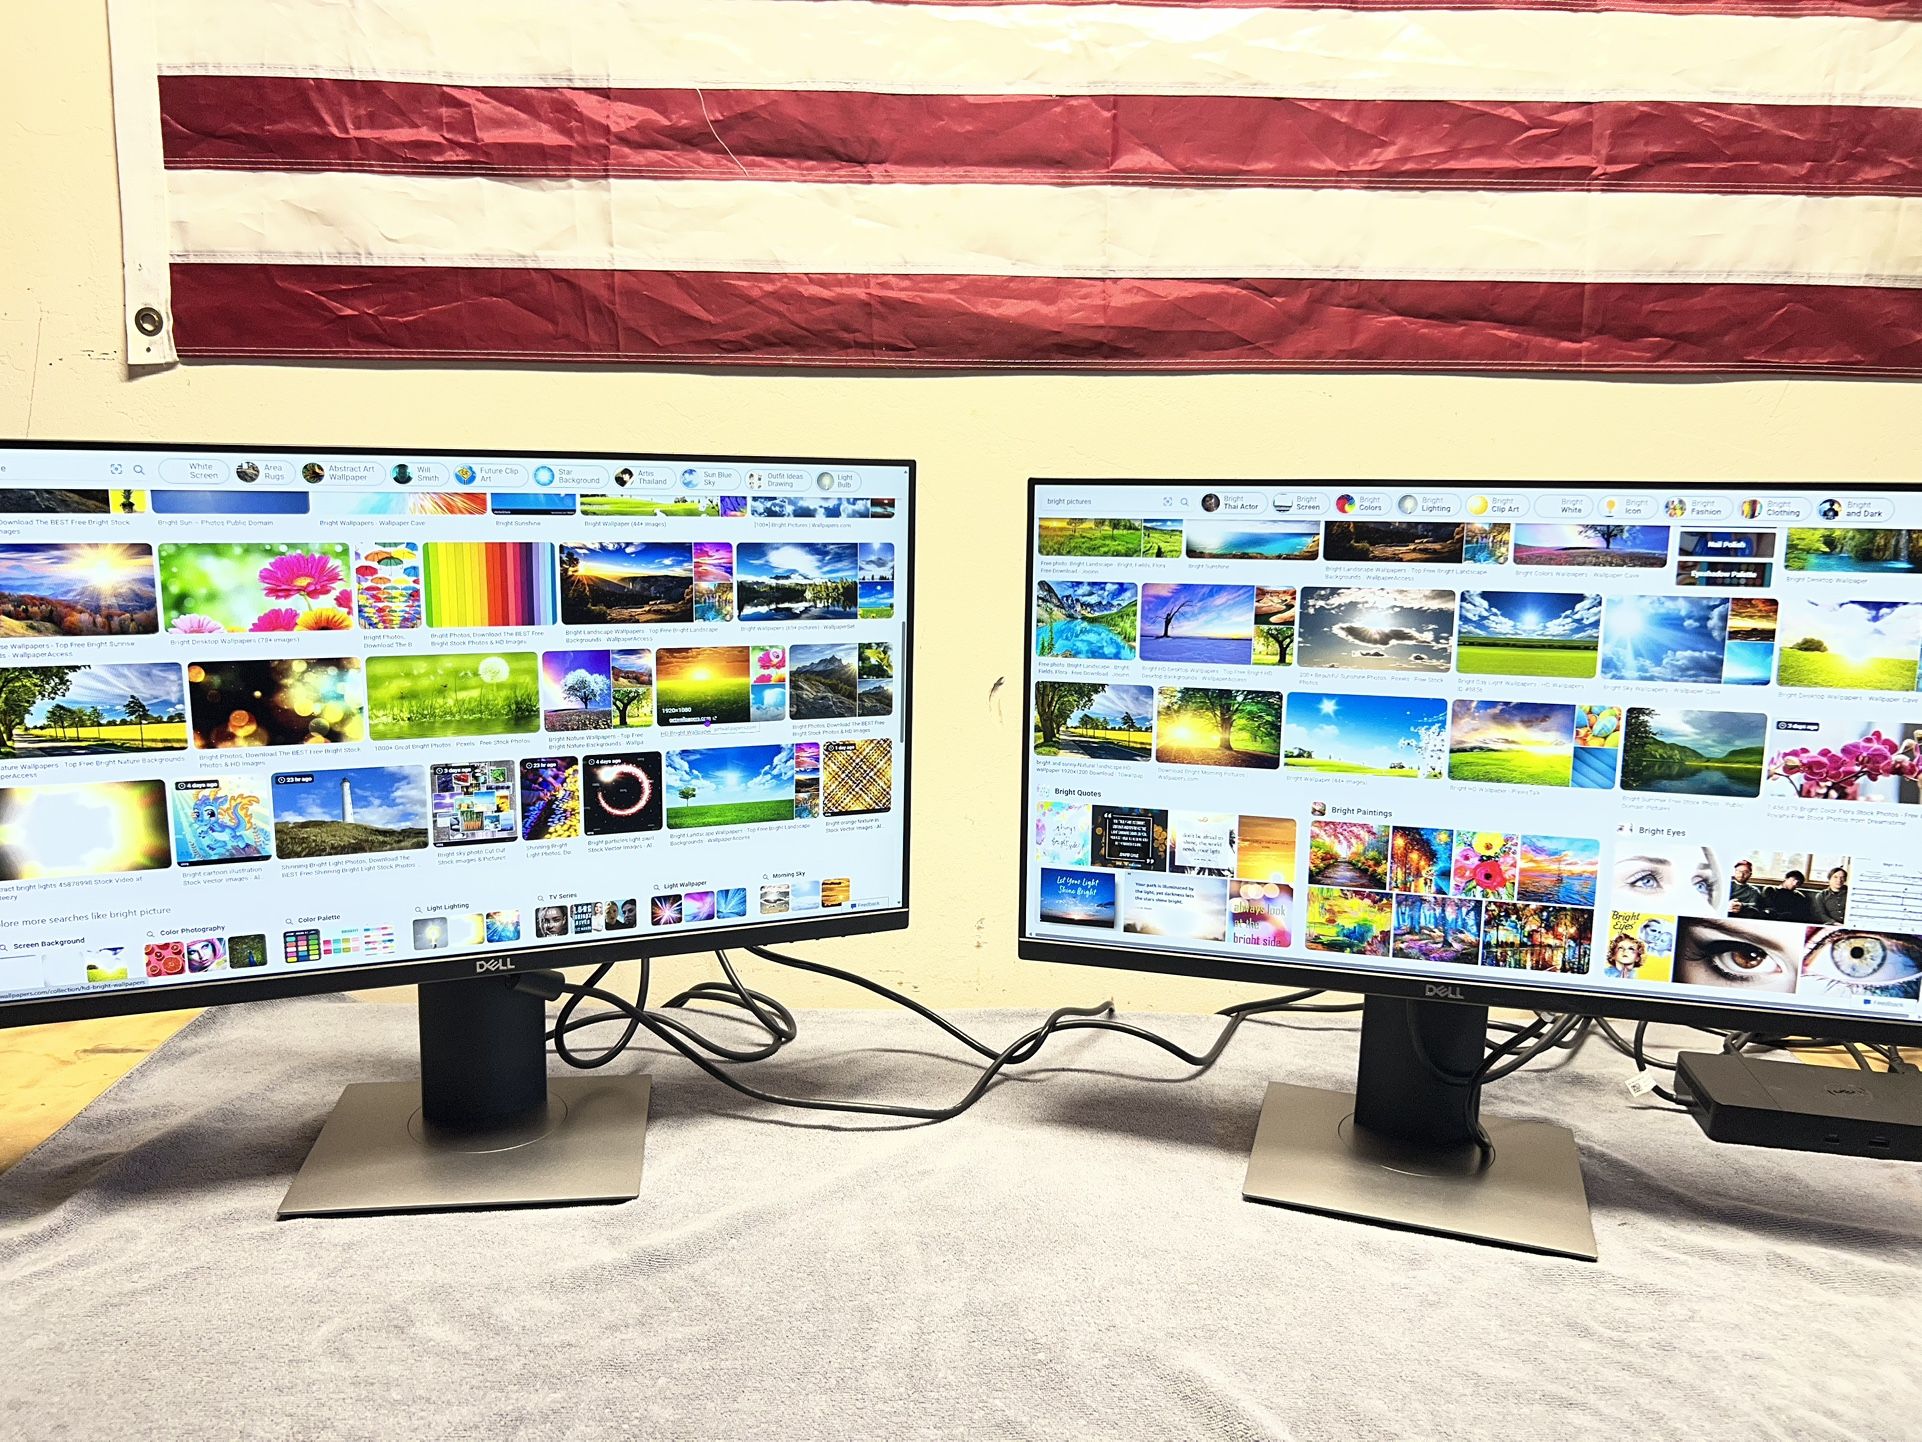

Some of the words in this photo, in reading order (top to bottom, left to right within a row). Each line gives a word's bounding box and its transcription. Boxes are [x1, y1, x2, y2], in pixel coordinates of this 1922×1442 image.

[190, 463, 212, 471] White
[264, 464, 282, 472] Area
[190, 472, 218, 480] Screen
[505, 468, 518, 476] Clip
[558, 468, 572, 476] Star
[768, 472, 786, 480] Outfit
[264, 472, 284, 481] Rugs
[329, 474, 368, 482] Wallpaper
[418, 474, 439, 482] Smith
[558, 476, 600, 484] Background
[838, 474, 852, 482] Light
[704, 479, 715, 487] Sky
[768, 480, 793, 488] Drawing
[1048, 498, 1064, 506] bright
[1067, 498, 1092, 506] pictures
[1224, 495, 1244, 503] Bright
[1297, 496, 1317, 504] Bright
[1360, 496, 1380, 504] Bright
[1422, 496, 1443, 504] Bright
[1562, 498, 1583, 506] Bright
[1360, 504, 1382, 512] Colors
[1692, 500, 1714, 508] Bright
[1768, 500, 1790, 508] Bright
[1422, 505, 1451, 513] Lighting
[1492, 505, 1506, 514] Clip
[1562, 506, 1582, 514] White
[1692, 508, 1722, 516] Fashion
[1767, 509, 1800, 518] Clothing
[1863, 510, 1882, 518] Dark
[340, 520, 374, 528] Wallpapers
[379, 520, 408, 528] Wallpaper
[602, 520, 628, 528] Wallpaper
[10, 643, 50, 651] Wallpapers
[56, 642, 68, 650] Top
[1055, 788, 1075, 797] Bright
[1078, 789, 1102, 798] Quotes
[1332, 806, 1354, 816] Bright
[1357, 808, 1392, 818] Paintings
[1639, 827, 1664, 836] Bright
[1666, 829, 1686, 837] Eyes
[773, 872, 794, 880] Morning
[664, 882, 679, 890] Light
[680, 880, 706, 888] Wallpaper
[559, 892, 577, 900] Series
[445, 902, 469, 912] Lighting
[1234, 902, 1264, 915] always
[1267, 903, 1285, 916] look
[22, 918, 46, 926] more
[49, 914, 89, 924] searches
[92, 912, 107, 920] like
[110, 909, 138, 920] bright
[140, 906, 171, 917] picture
[318, 914, 340, 922] Palette
[1612, 910, 1640, 920] Bright
[1245, 919, 1259, 929] the
[1613, 921, 1633, 930] Eyes
[180, 925, 225, 935] Photography
[14, 942, 39, 950] Screen
[42, 937, 85, 948] Background
[1233, 933, 1260, 946] bright
[476, 958, 515, 973] DELL
[1424, 984, 1464, 999] DELL
